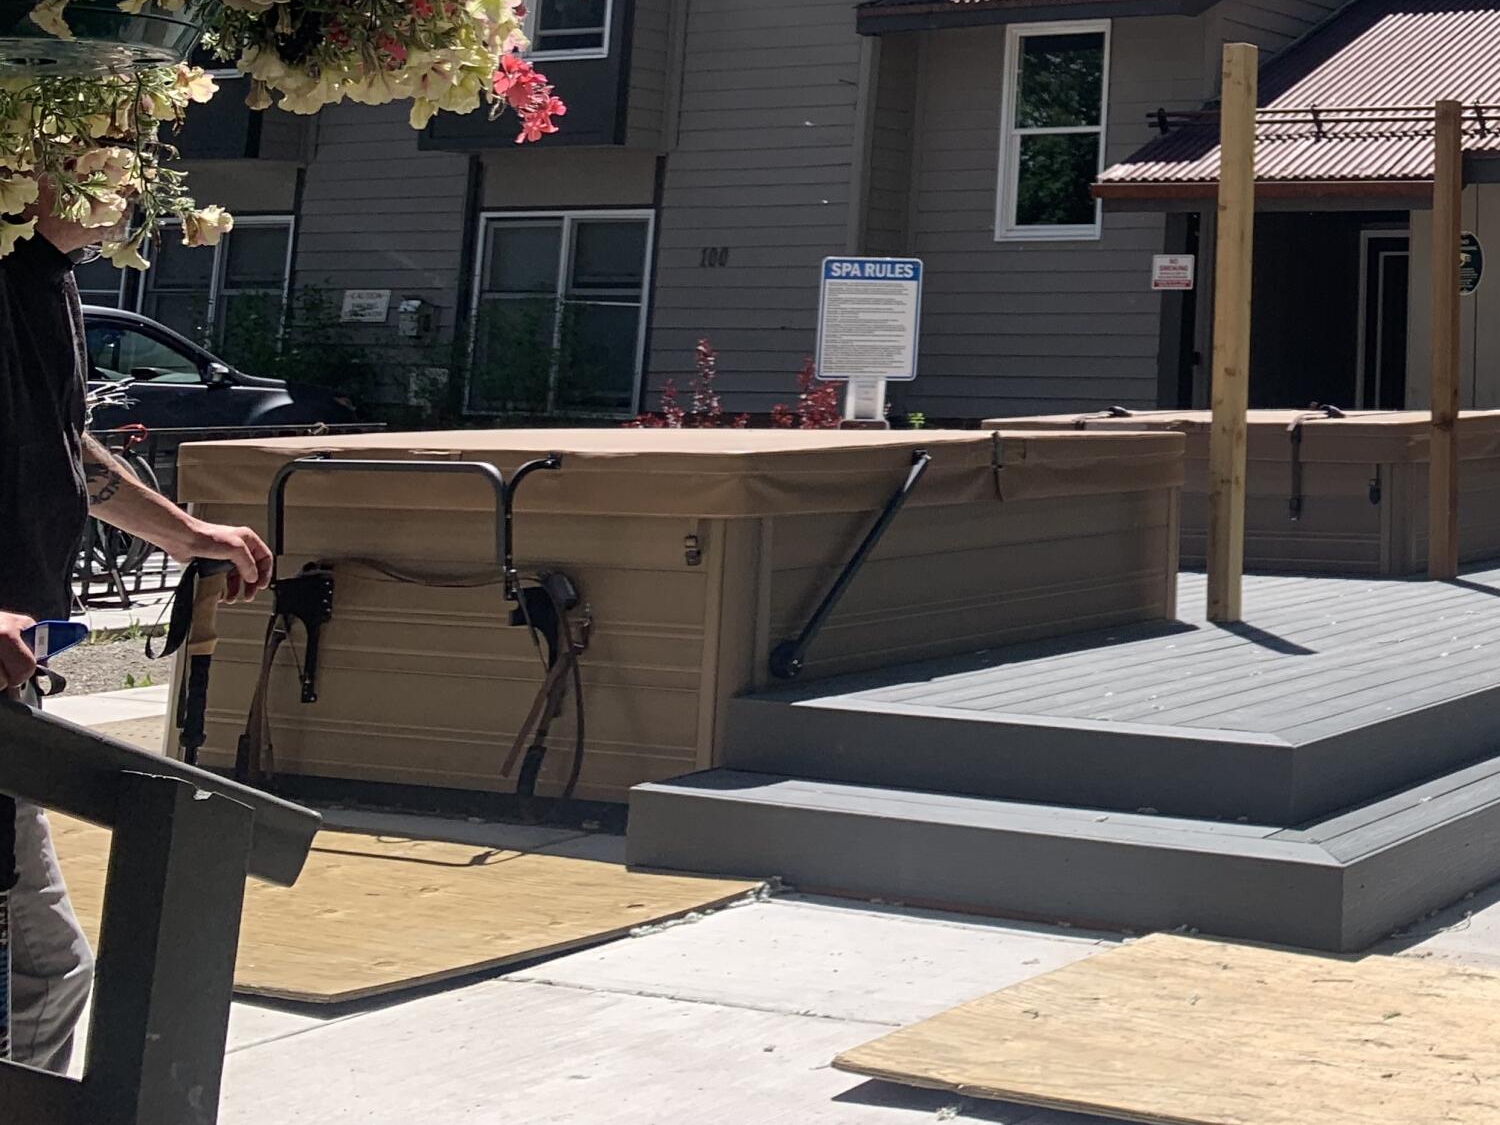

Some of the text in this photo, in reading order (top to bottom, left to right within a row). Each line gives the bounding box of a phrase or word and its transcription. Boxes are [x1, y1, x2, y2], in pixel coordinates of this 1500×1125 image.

[699, 247, 729, 268] 100
[831, 263, 914, 278] SPA RULES
